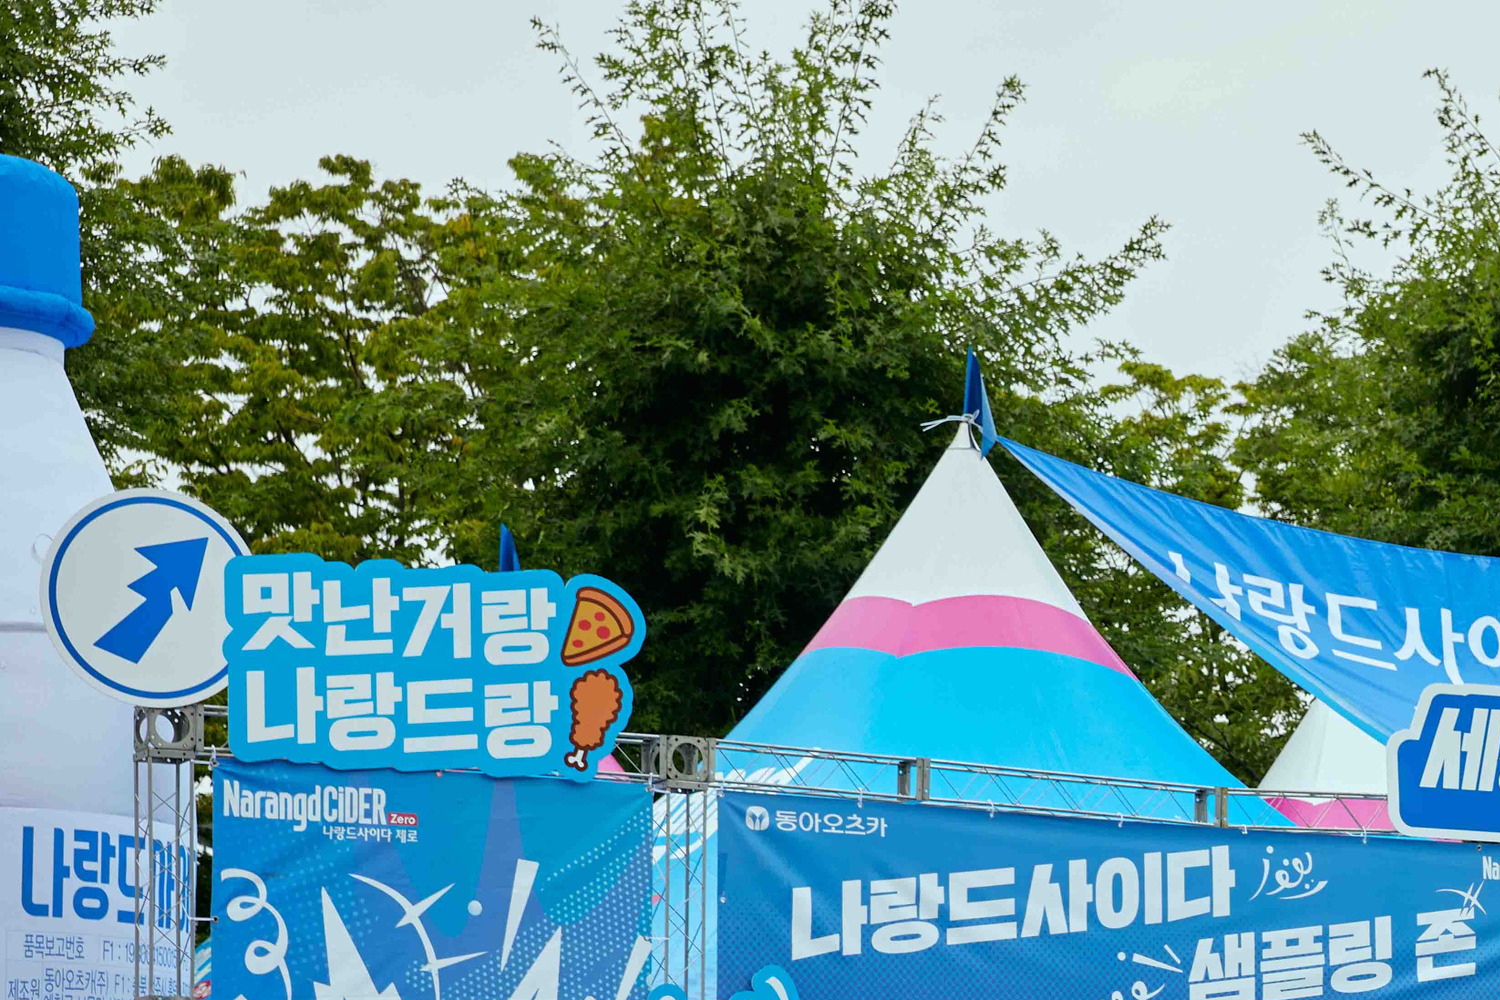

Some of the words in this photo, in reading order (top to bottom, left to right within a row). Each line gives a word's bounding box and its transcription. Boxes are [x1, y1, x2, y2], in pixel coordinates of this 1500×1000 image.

[242, 571, 556, 666] 맛난거랑
[246, 666, 558, 760] 나랑드랑
[390, 814, 416, 824] Zero
[775, 810, 888, 837] 동아오츠카
[323, 826, 392, 842] 나랑드사이다
[396, 829, 418, 843] 제로
[792, 845, 1235, 960] 나랑드사이다
[24, 934, 84, 959] 품목보고번호
[1416, 907, 1477, 983] 존
[44, 967, 109, 995] 동아오츠카(주)
